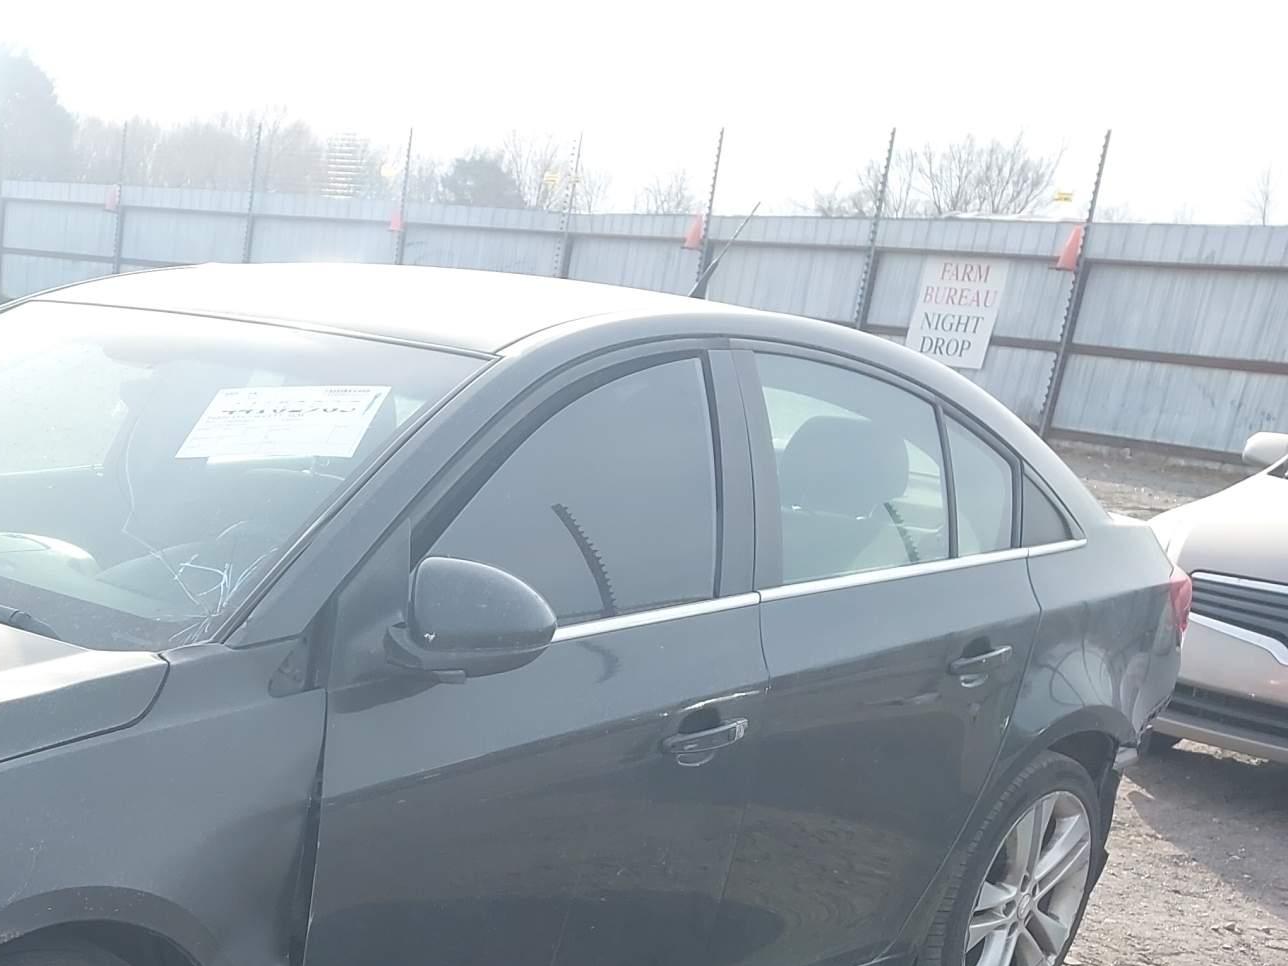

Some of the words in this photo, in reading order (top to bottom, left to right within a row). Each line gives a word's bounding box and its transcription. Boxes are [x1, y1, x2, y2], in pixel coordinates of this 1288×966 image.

[940, 262, 991, 283] FARM
[923, 286, 998, 308] BUREAU
[920, 312, 985, 334] NIGHT
[919, 336, 972, 358] DROP
